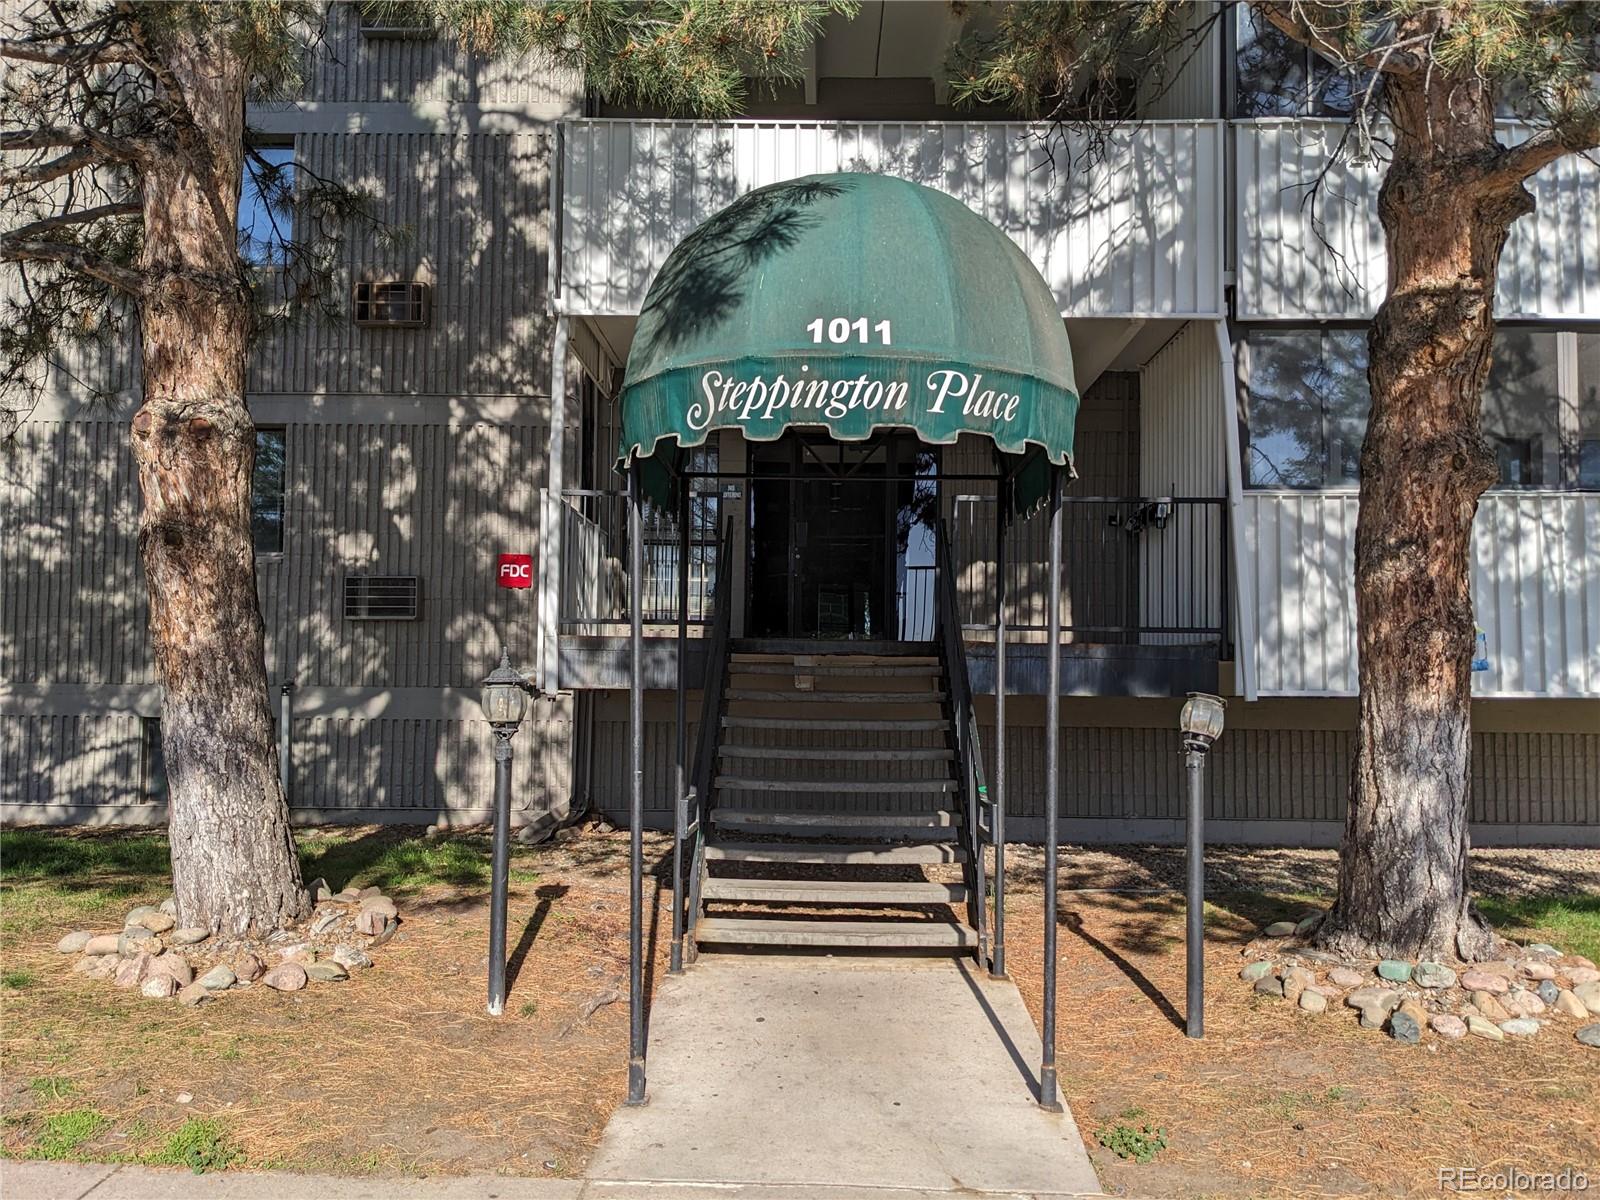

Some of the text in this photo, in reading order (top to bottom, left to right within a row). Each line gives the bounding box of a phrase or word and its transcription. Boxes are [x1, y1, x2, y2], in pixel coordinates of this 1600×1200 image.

[806, 318, 892, 345] 1011
[687, 365, 1021, 430] Steppington Place
[500, 564, 530, 578] FDC
